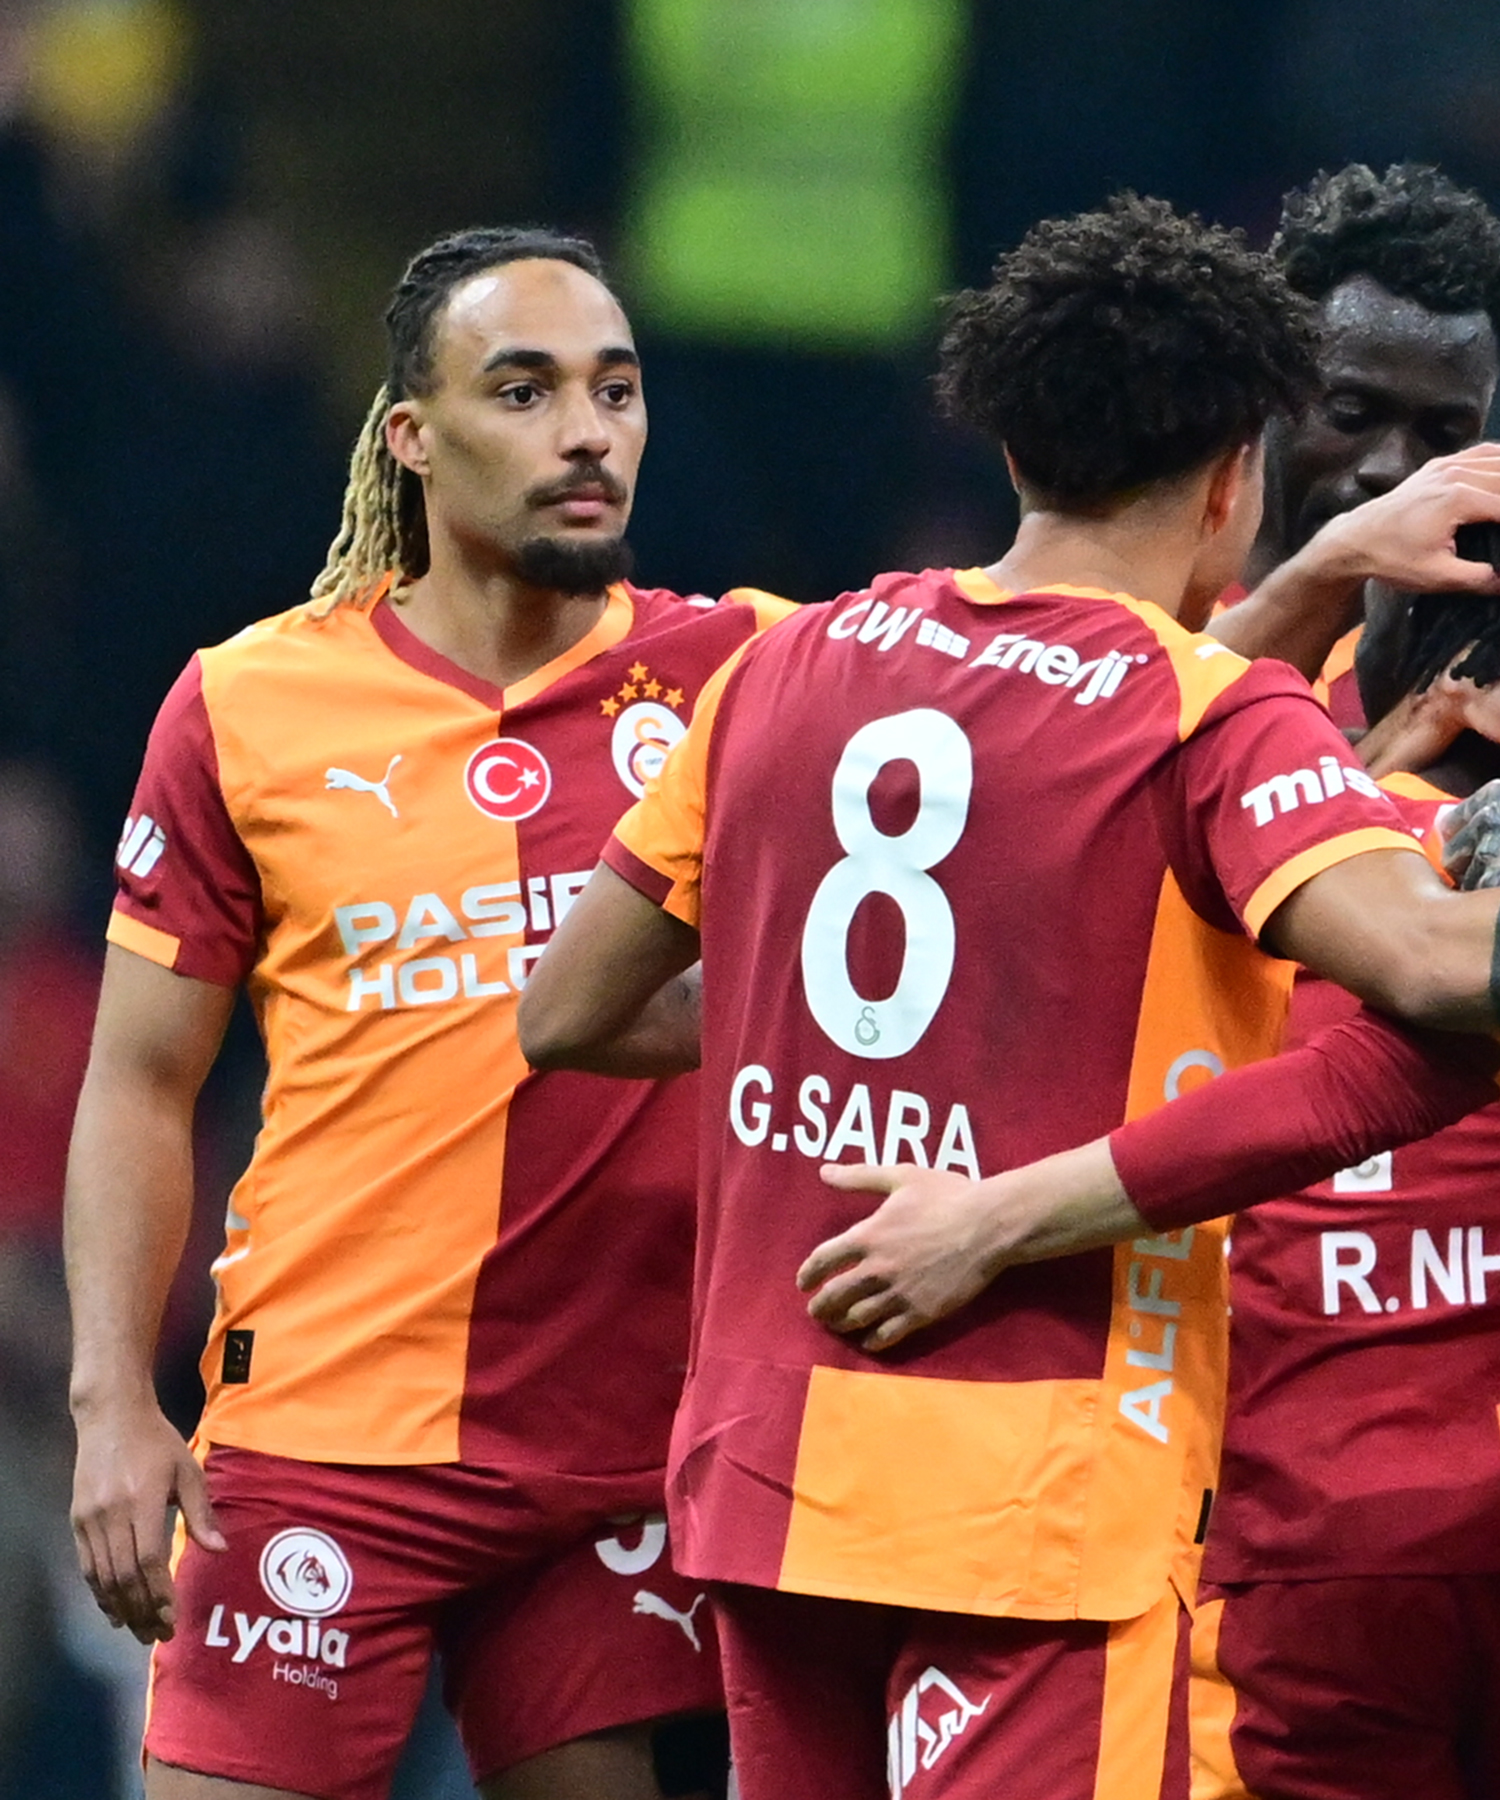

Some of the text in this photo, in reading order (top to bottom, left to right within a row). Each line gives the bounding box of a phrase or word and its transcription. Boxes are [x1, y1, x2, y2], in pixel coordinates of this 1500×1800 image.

[826, 597, 1134, 706] CW Enerji
[1240, 755, 1393, 828] mis
[801, 706, 973, 1060] 8
[729, 1063, 982, 1182] G.SARA
[272, 1661, 338, 1700] Holding
